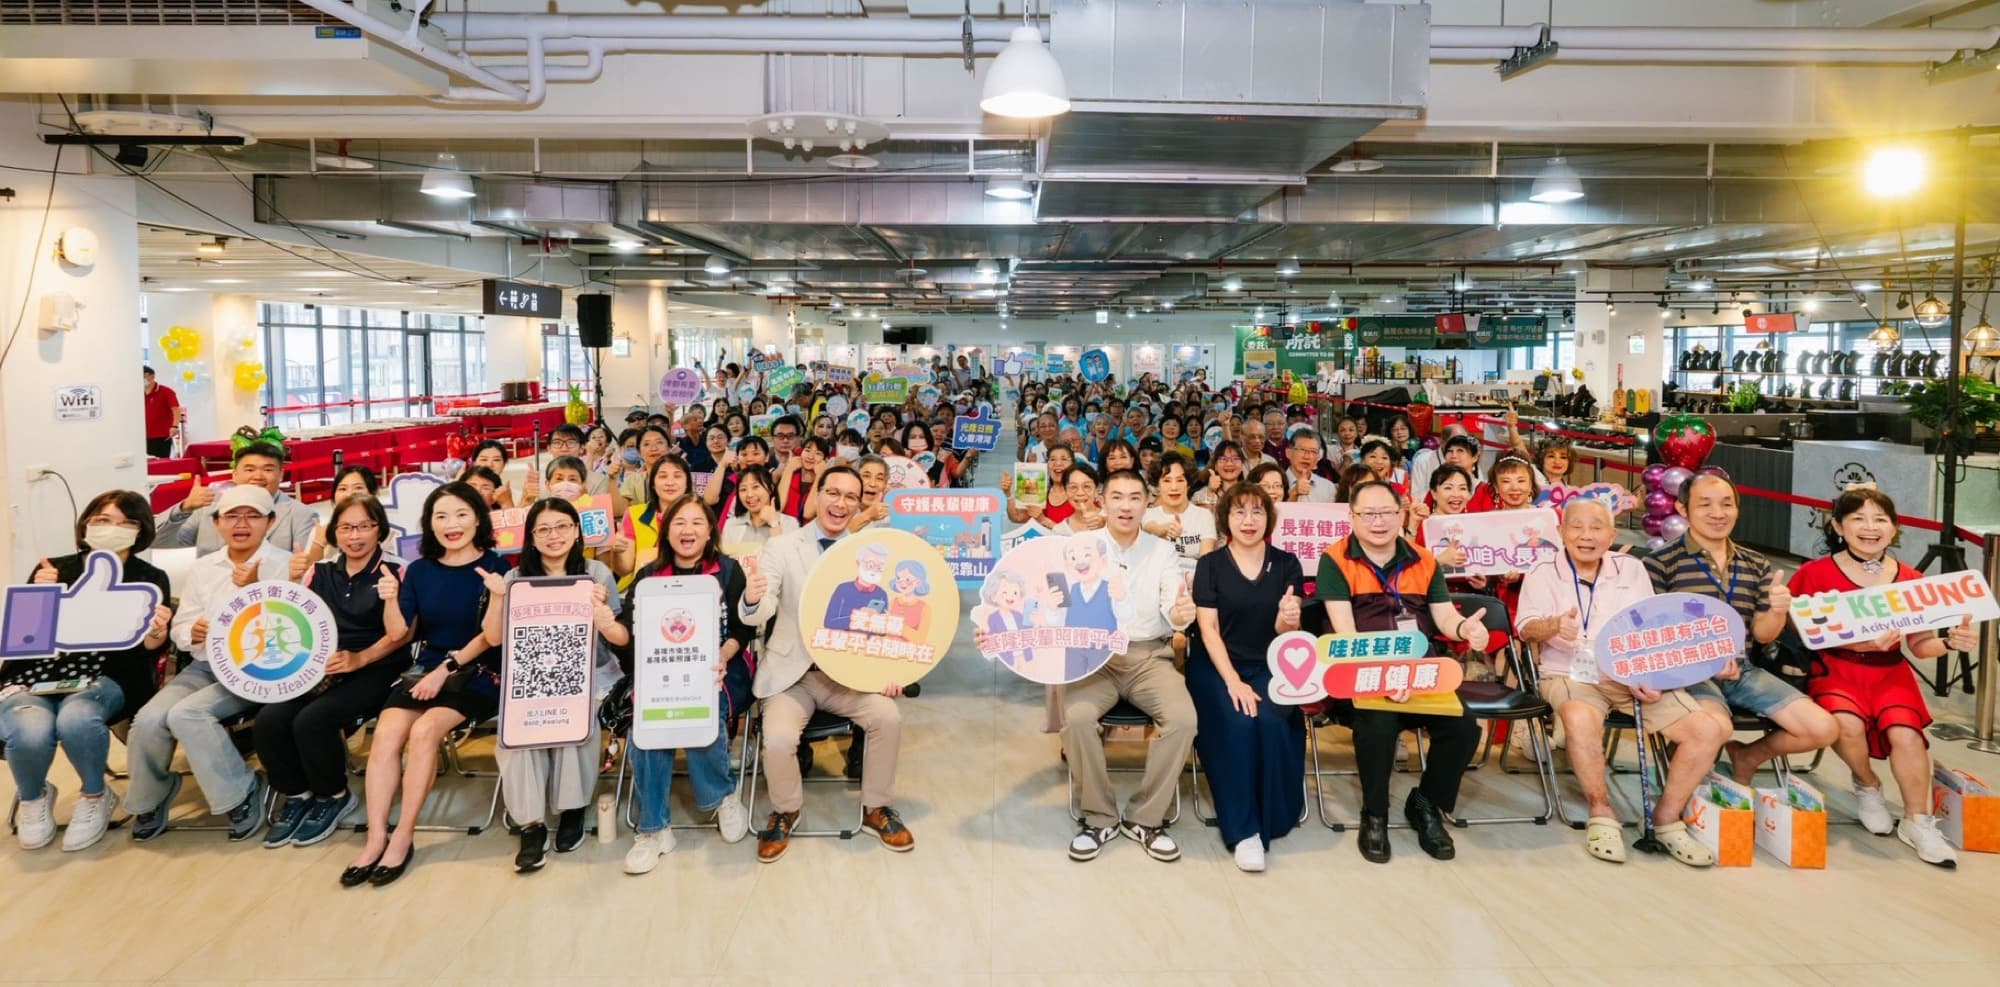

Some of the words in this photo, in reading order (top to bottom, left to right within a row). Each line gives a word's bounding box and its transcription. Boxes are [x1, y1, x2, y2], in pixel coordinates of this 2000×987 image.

[901, 496, 990, 512] 守護長輩健康
[1281, 519, 1351, 537] 長輩健康
[217, 585, 318, 627] 基隆市衛生局
[1846, 574, 1986, 619] KEELUNG
[984, 629, 1128, 653] 基隆長輩照護平台
[1608, 615, 1729, 654] 長輩健康有平台
[1861, 625, 1870, 635] A
[1871, 621, 1890, 633] city
[1891, 616, 1912, 630] full
[1912, 615, 1925, 626] of
[212, 637, 240, 686] Keelung
[243, 680, 271, 698] City
[277, 668, 318, 695] Health
[313, 620, 329, 665] Bureau
[811, 628, 935, 664] 長輩平台隨時在
[1328, 636, 1412, 657] 哇抵基隆
[1612, 638, 1737, 678] 專業諮詢無阻礙
[1354, 663, 1440, 692] 顧健康
